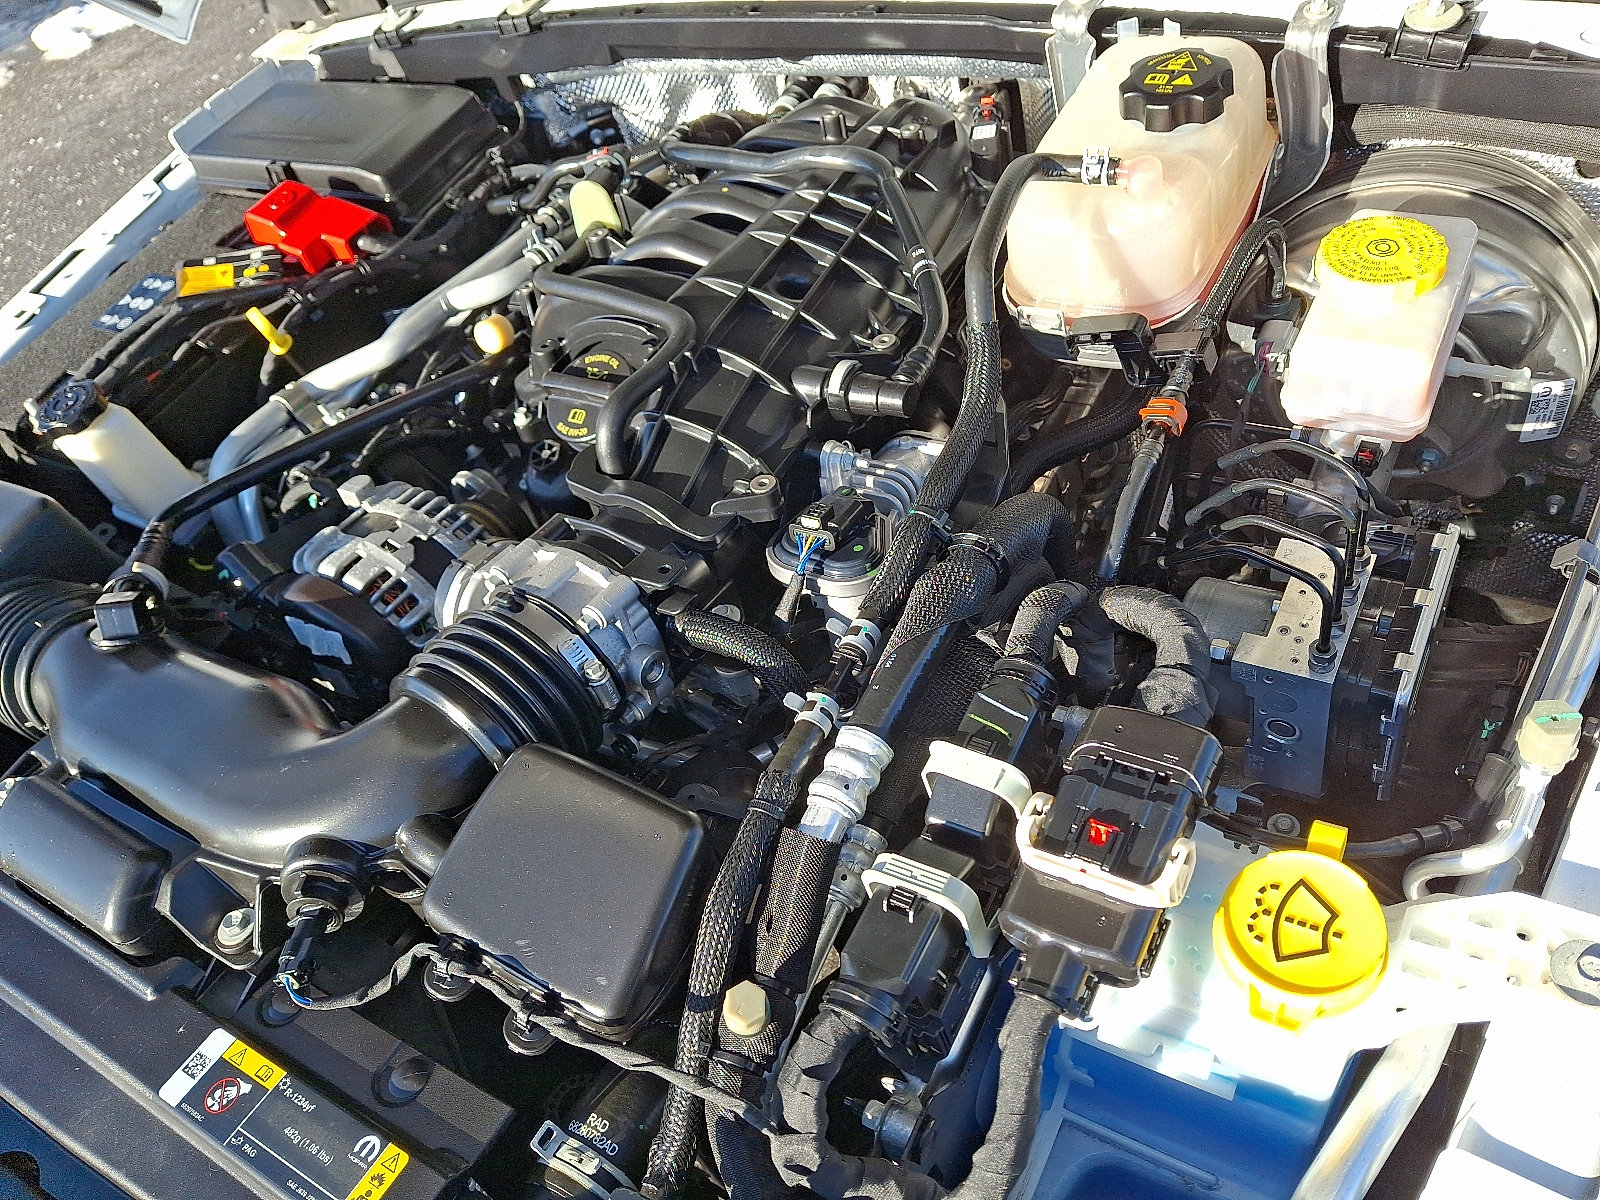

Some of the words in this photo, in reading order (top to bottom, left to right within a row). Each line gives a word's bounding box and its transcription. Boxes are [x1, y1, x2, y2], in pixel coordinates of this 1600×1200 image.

[584, 354, 611, 364] ENGINE
[609, 357, 620, 370] OIL
[556, 421, 569, 435] SAE
[283, 1088, 317, 1113] R-1234yf
[586, 1112, 610, 1133] RAD
[283, 1126, 301, 1145] 482g
[299, 1137, 319, 1155] (1.06
[317, 1149, 334, 1167] lbs)
[568, 1119, 619, 1156] 68280782AD
[241, 1143, 258, 1159] PAG
[346, 1152, 368, 1170] MOPAR
[286, 1179, 298, 1190] SAE
